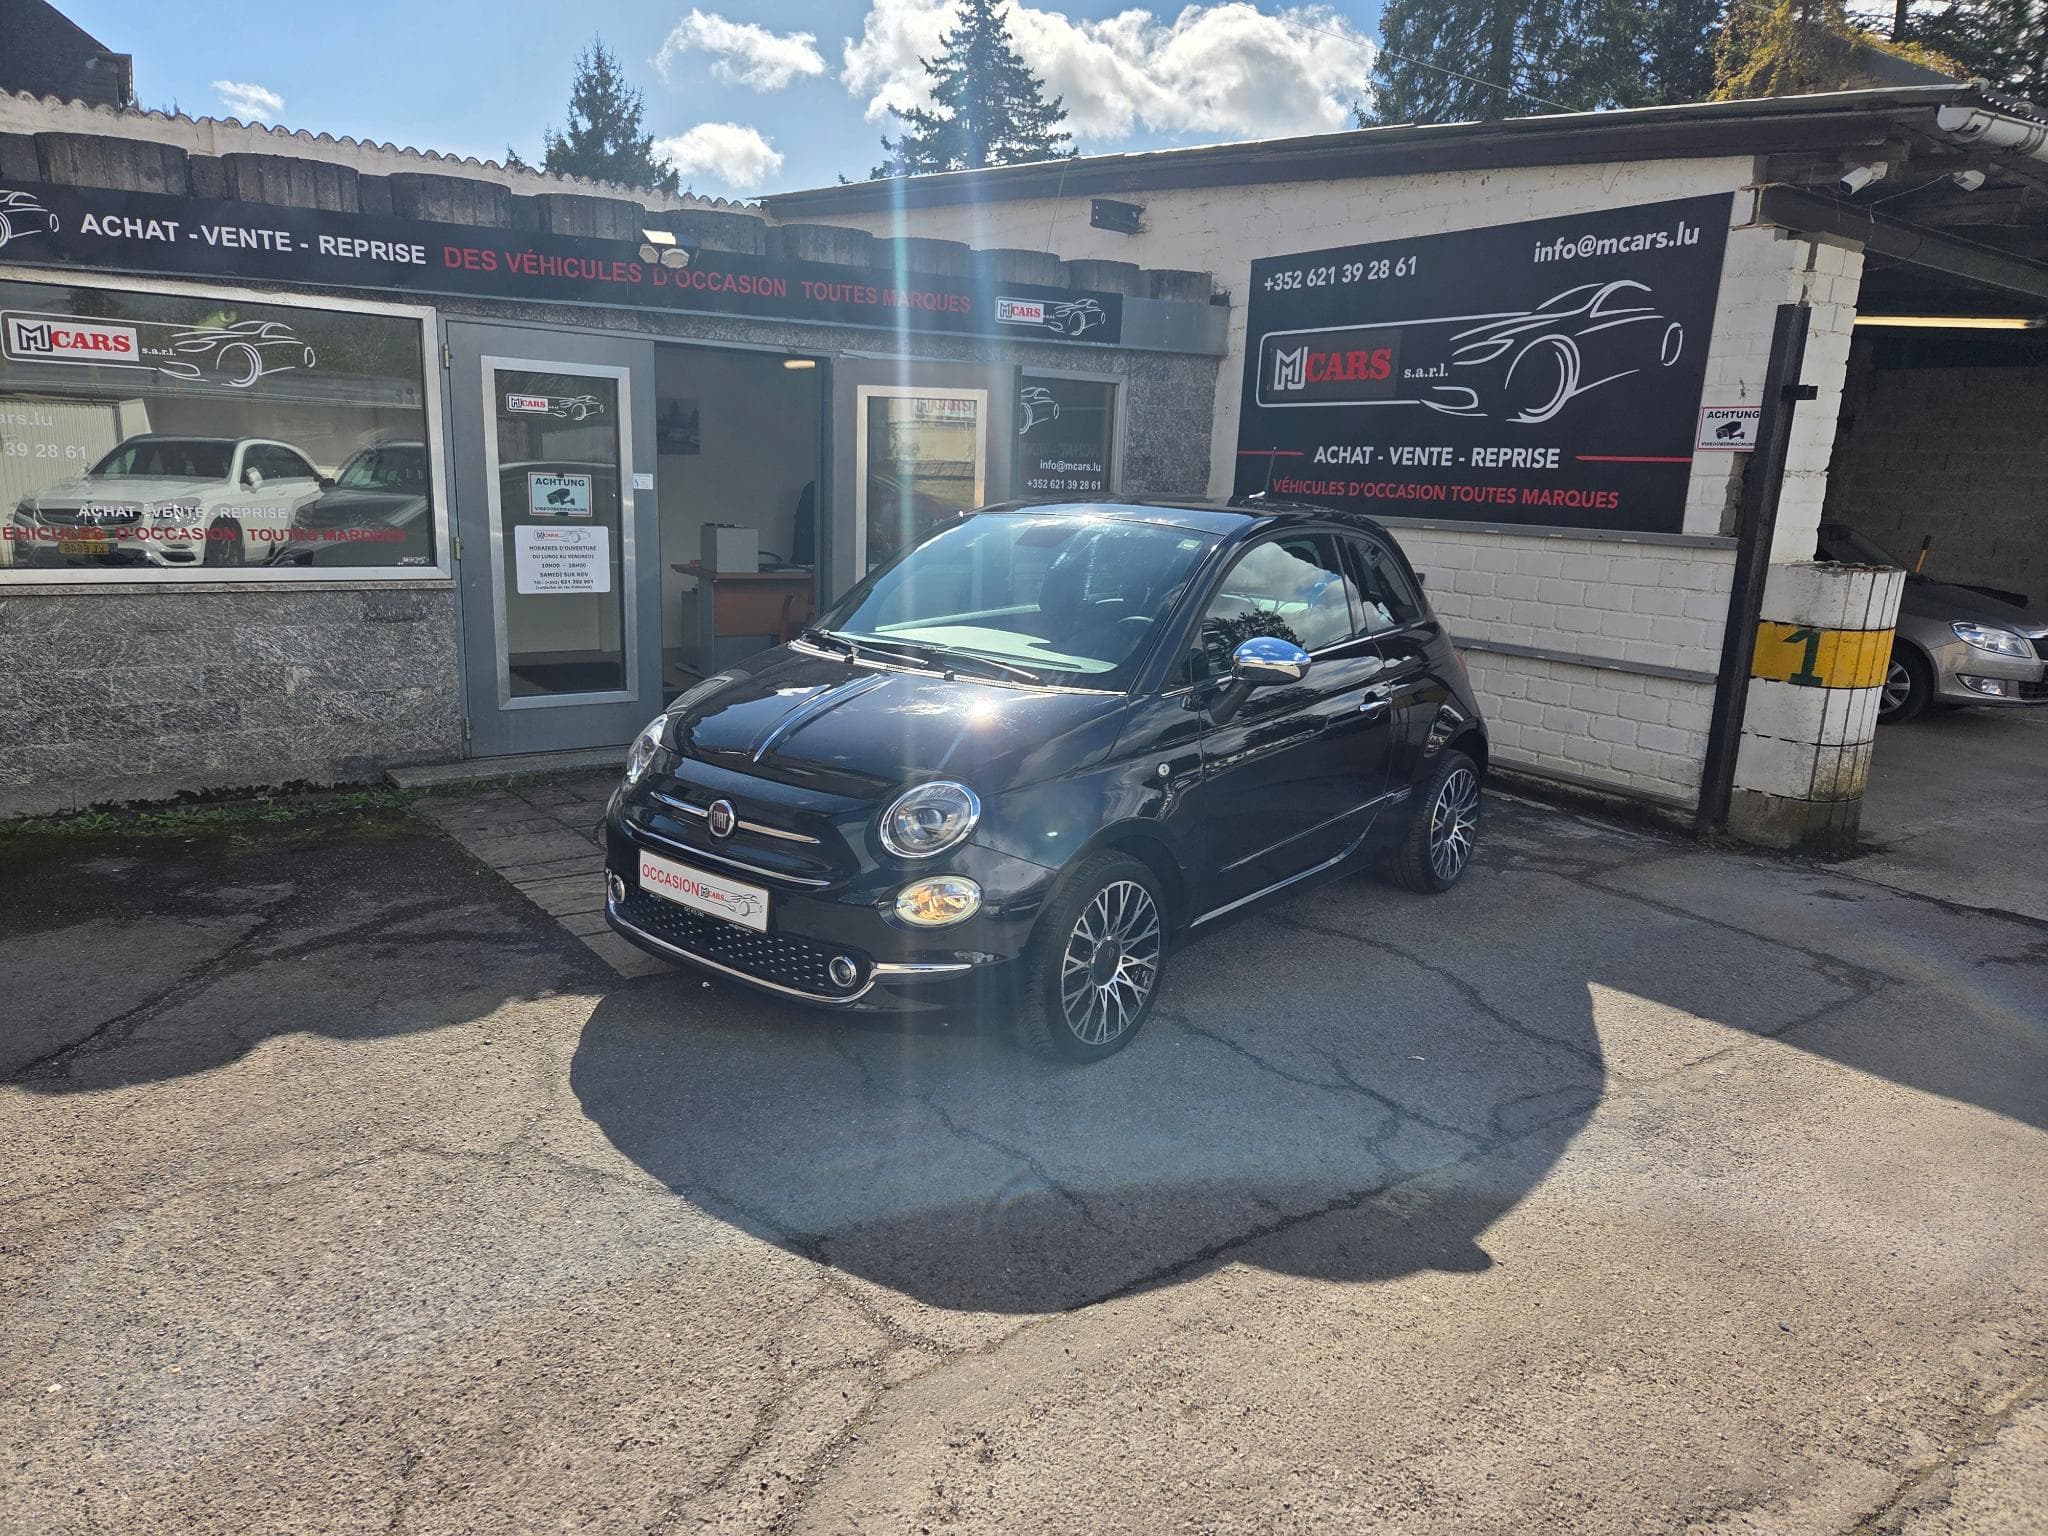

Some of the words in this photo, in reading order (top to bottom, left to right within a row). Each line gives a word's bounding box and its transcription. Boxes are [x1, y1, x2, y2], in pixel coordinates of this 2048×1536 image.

[1534, 221, 1700, 263] info@mcars.lu
[81, 213, 180, 242] ACHAT
[319, 235, 427, 265] REPRISE
[443, 246, 498, 271] DES
[504, 249, 642, 283] VÉHICULES
[801, 280, 877, 305] TOUTES
[883, 288, 971, 313] MARQUES
[1264, 270, 1302, 291] +352
[1307, 266, 1336, 287] 621
[1342, 262, 1363, 283] 39
[1368, 259, 1390, 280] 28
[1395, 255, 1417, 277] 61
[142, 347, 177, 356] s.a.r.l.
[1404, 363, 1449, 378] s.a.r.l.
[1707, 410, 1760, 419] ACHTUNG
[35, 443, 59, 458] 28
[65, 445, 87, 460] 61
[1314, 446, 1374, 464] ACHAT
[1390, 447, 1453, 466] VENTE
[1471, 447, 1561, 469] REPRISE
[1040, 459, 1101, 473] info@mcars.lu
[535, 477, 585, 487] ACHTUNG
[1027, 479, 1048, 489] +352
[1050, 479, 1065, 489] 621
[1068, 480, 1078, 490] 39
[1080, 480, 1089, 490] 28
[1091, 480, 1101, 490] 61
[1273, 476, 1345, 496] VÉHICULES
[1349, 482, 1447, 501] D'OCCASION
[1451, 486, 1518, 504] TOUTES
[1522, 488, 1620, 509] MARQUES
[78, 504, 136, 518] ACHAT
[220, 507, 288, 519] REPRISE
[0, 523, 107, 542] ÉHICULES
[248, 528, 318, 542] TOUTES
[1782, 629, 1824, 686] 1
[712, 811, 728, 830] FIAT
[642, 864, 700, 897] OCCASION
